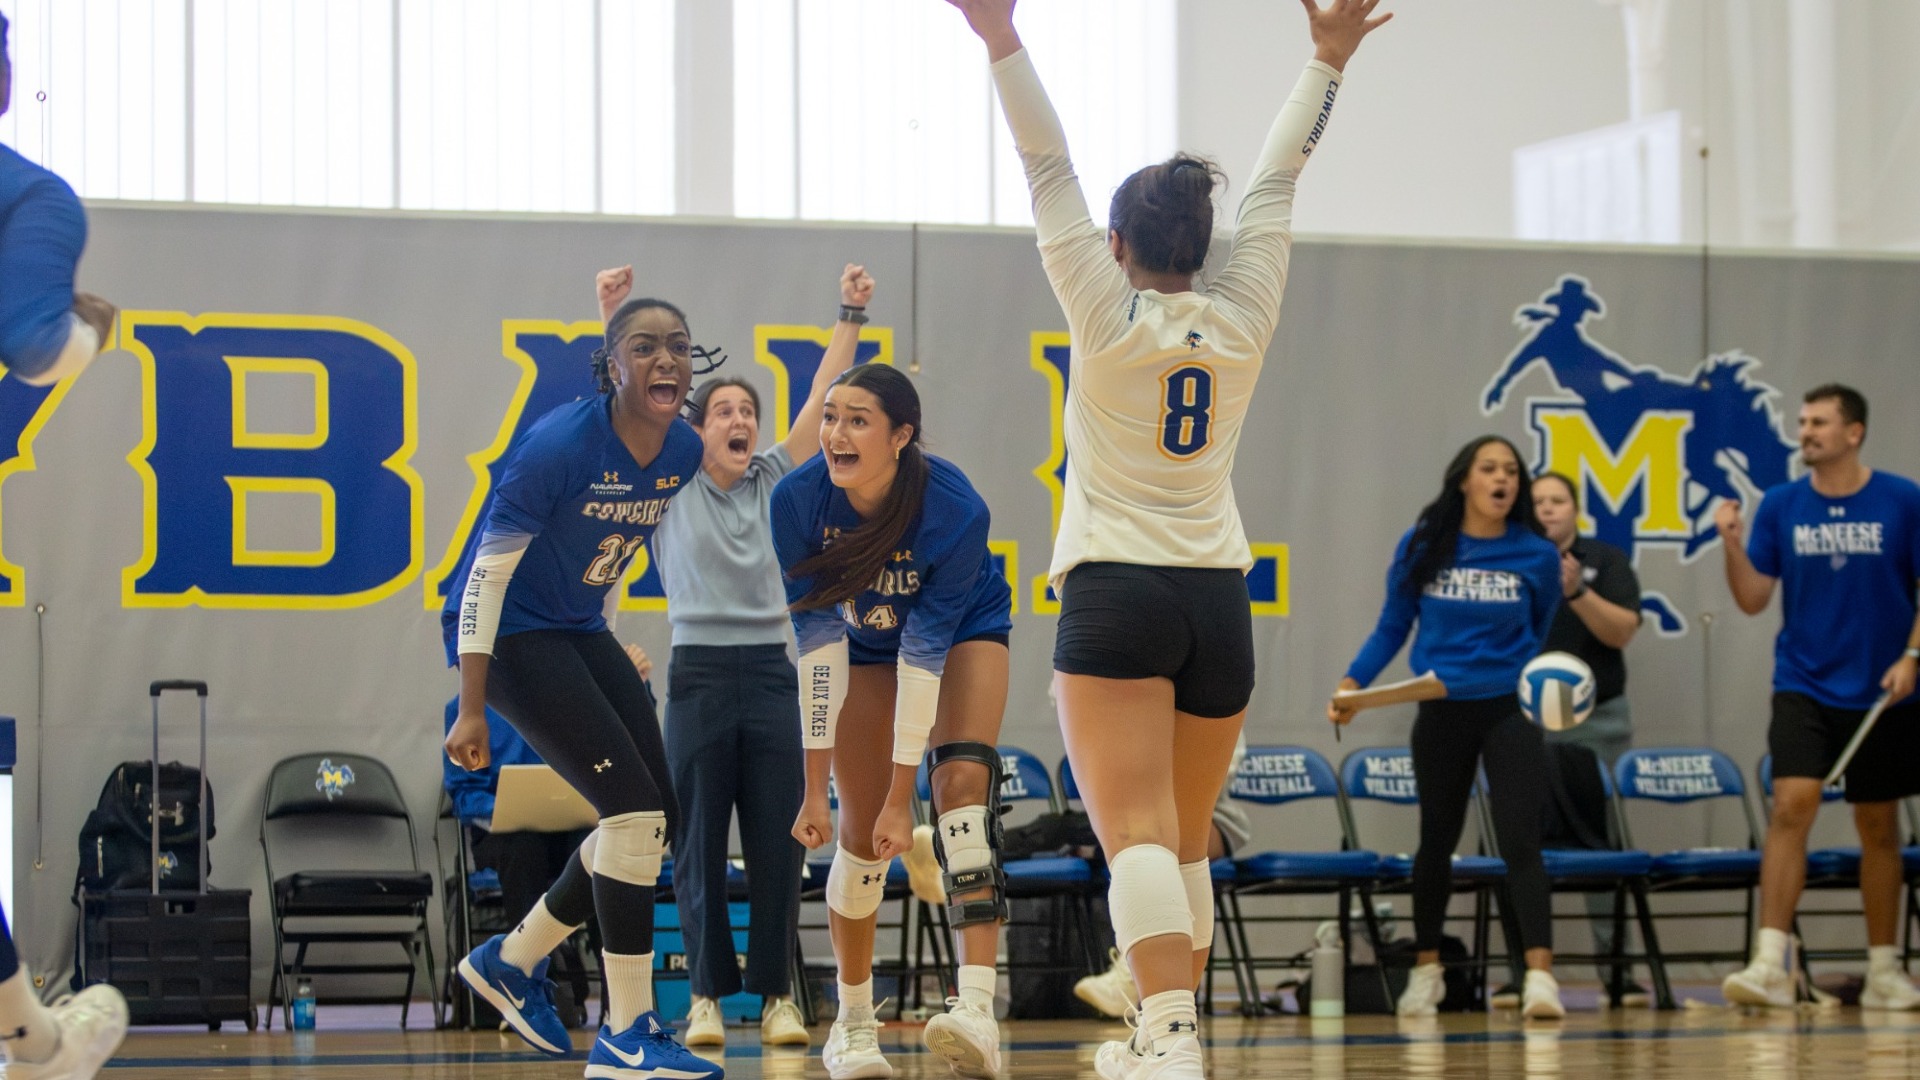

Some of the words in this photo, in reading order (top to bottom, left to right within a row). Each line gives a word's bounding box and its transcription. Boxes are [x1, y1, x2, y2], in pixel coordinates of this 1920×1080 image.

[1302, 80, 1339, 157] COWGIRLS
[1157, 361, 1217, 462] 8
[655, 475, 680, 490] SLC
[1535, 408, 1695, 538] M
[589, 483, 633, 491] NAVARRE
[1794, 522, 1883, 542] McNEESE
[583, 534, 644, 586] 21
[867, 567, 921, 596] IRLS
[1435, 567, 1521, 588] cNEESE
[462, 602, 478, 636] POKES
[841, 598, 898, 630] 14
[812, 665, 830, 700] GEAUX
[811, 704, 828, 737] POKES
[1238, 754, 1306, 777] cNEESE
[1365, 757, 1414, 776] McNE
[1636, 755, 1714, 775] McNEESE
[1363, 778, 1416, 797] VOLLEY
[1634, 775, 1723, 797] VOLLEYBALL
